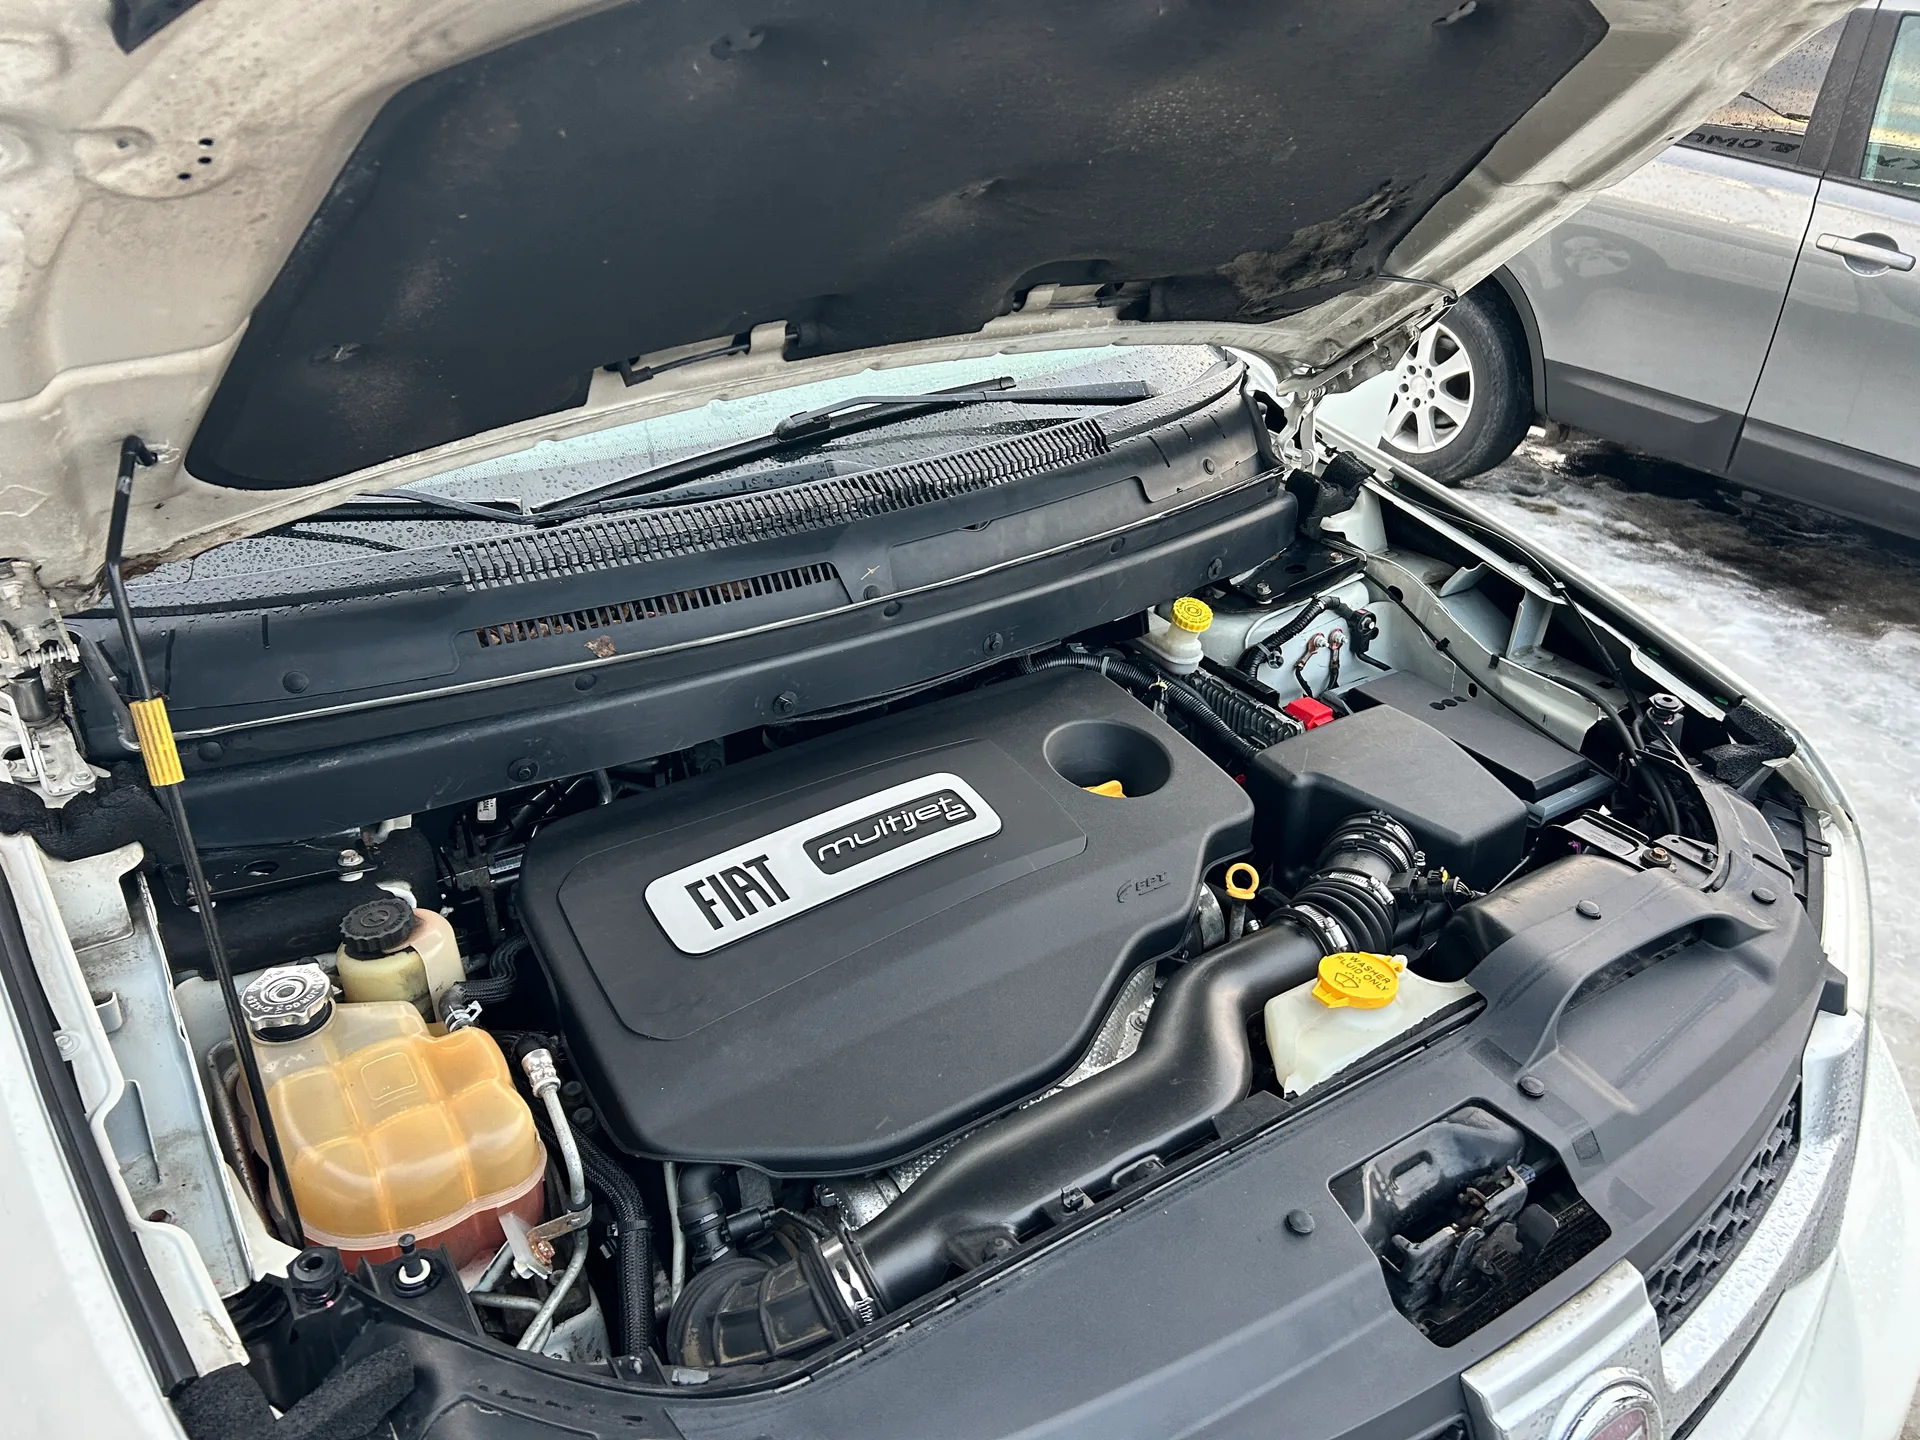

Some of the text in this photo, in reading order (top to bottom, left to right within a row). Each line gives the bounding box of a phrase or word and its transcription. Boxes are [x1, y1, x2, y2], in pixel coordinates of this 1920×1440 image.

[684, 853, 791, 931] FIAT
[1335, 956, 1389, 991] FLUID ONLY
[1350, 956, 1391, 984] WASHER
